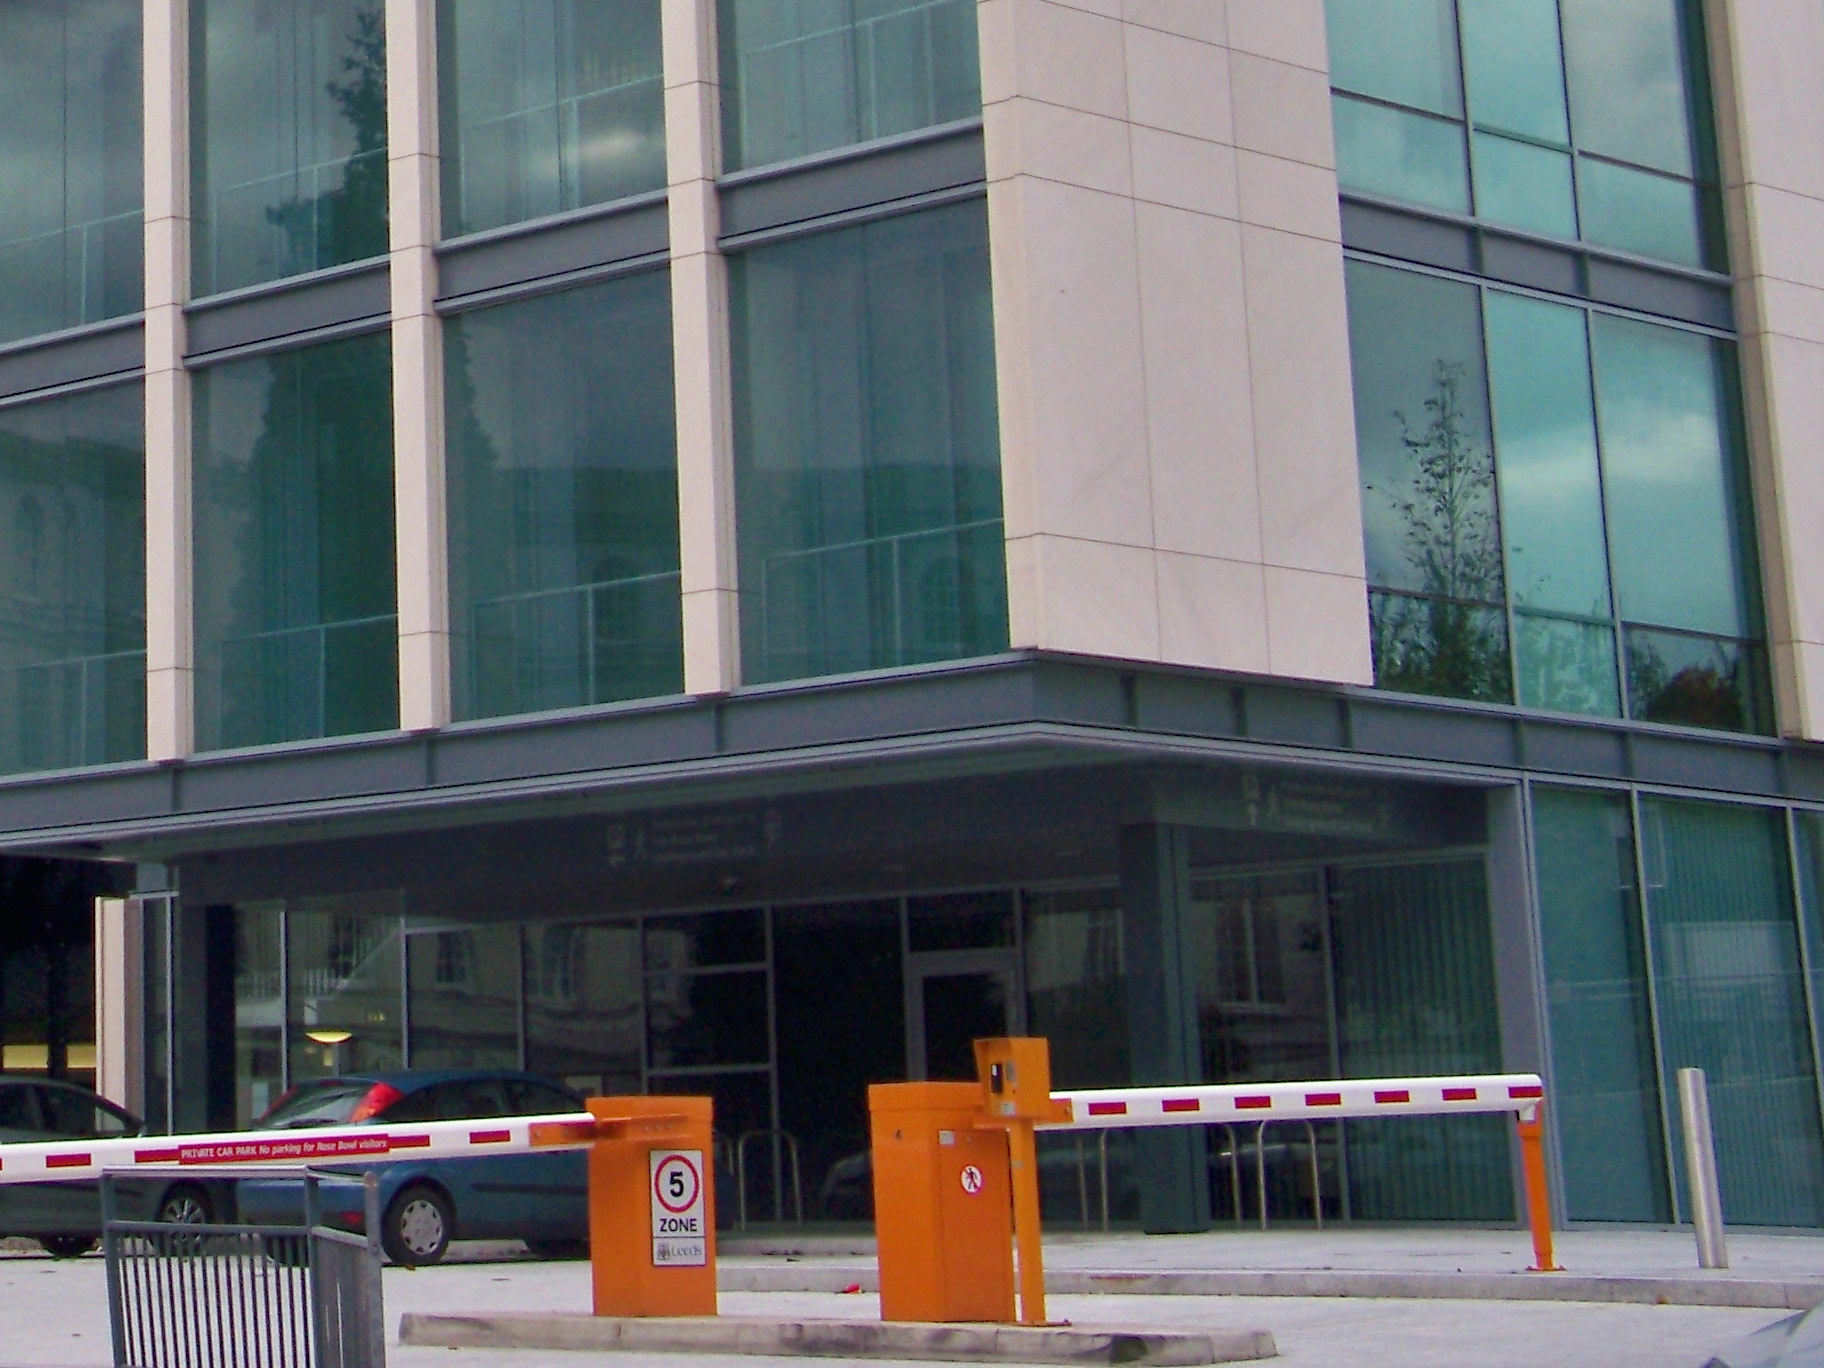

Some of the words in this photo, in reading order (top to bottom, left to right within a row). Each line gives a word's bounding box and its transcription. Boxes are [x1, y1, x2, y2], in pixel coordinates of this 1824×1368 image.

[181, 1147, 215, 1159] PRIVATE
[217, 1146, 234, 1157] CAR
[236, 1145, 257, 1156] PARK
[259, 1144, 270, 1155] No
[271, 1143, 302, 1156] parking
[303, 1141, 316, 1153] for
[317, 1140, 337, 1151] Rose
[338, 1140, 357, 1150] Bowl
[359, 1138, 388, 1149] visitors
[669, 1171, 685, 1198] 5
[659, 1218, 699, 1233] ZONE
[671, 1245, 702, 1257] Leeds
